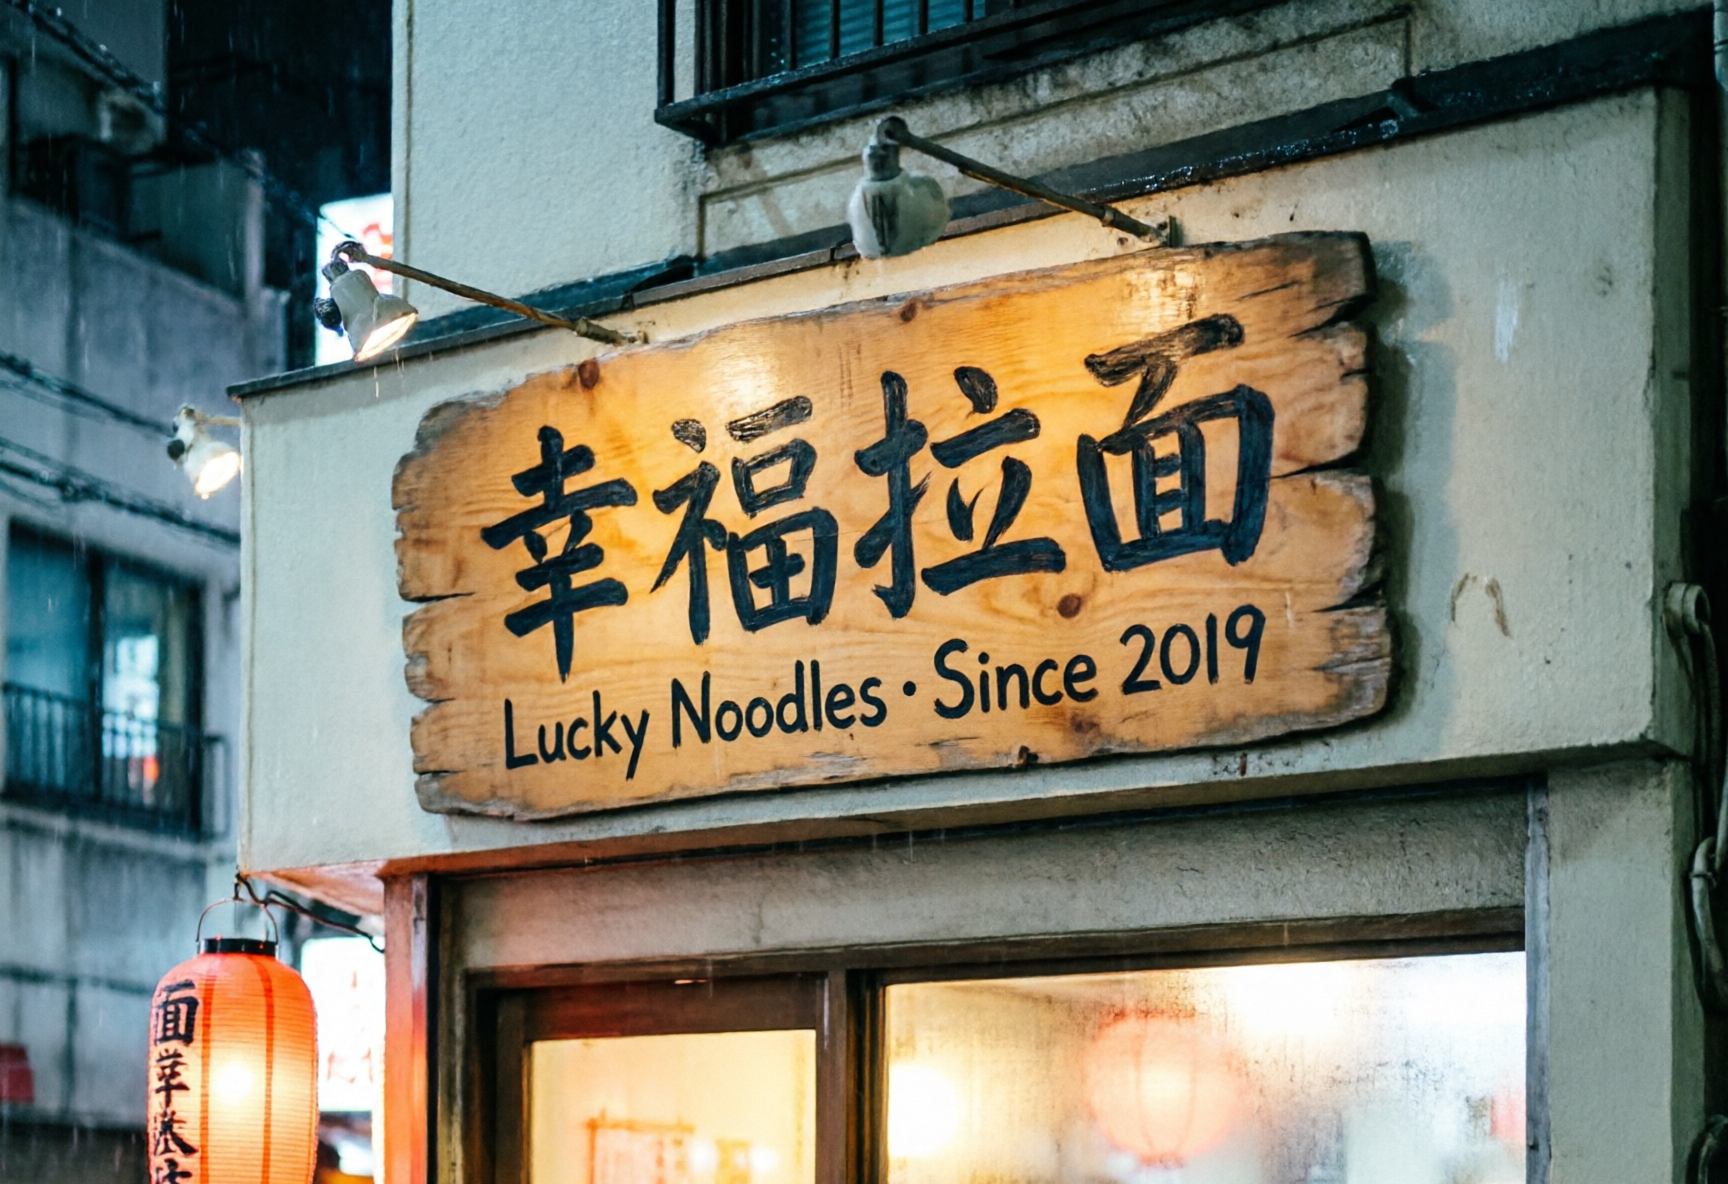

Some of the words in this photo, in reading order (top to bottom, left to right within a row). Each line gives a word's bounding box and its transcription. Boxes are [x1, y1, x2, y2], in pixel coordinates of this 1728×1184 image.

[481, 312, 1275, 682] 幸福拉面
[505, 691, 650, 780] Lucky
[672, 660, 888, 749] Noodles
[934, 640, 1100, 720] Since
[1121, 604, 1267, 695] 2019
